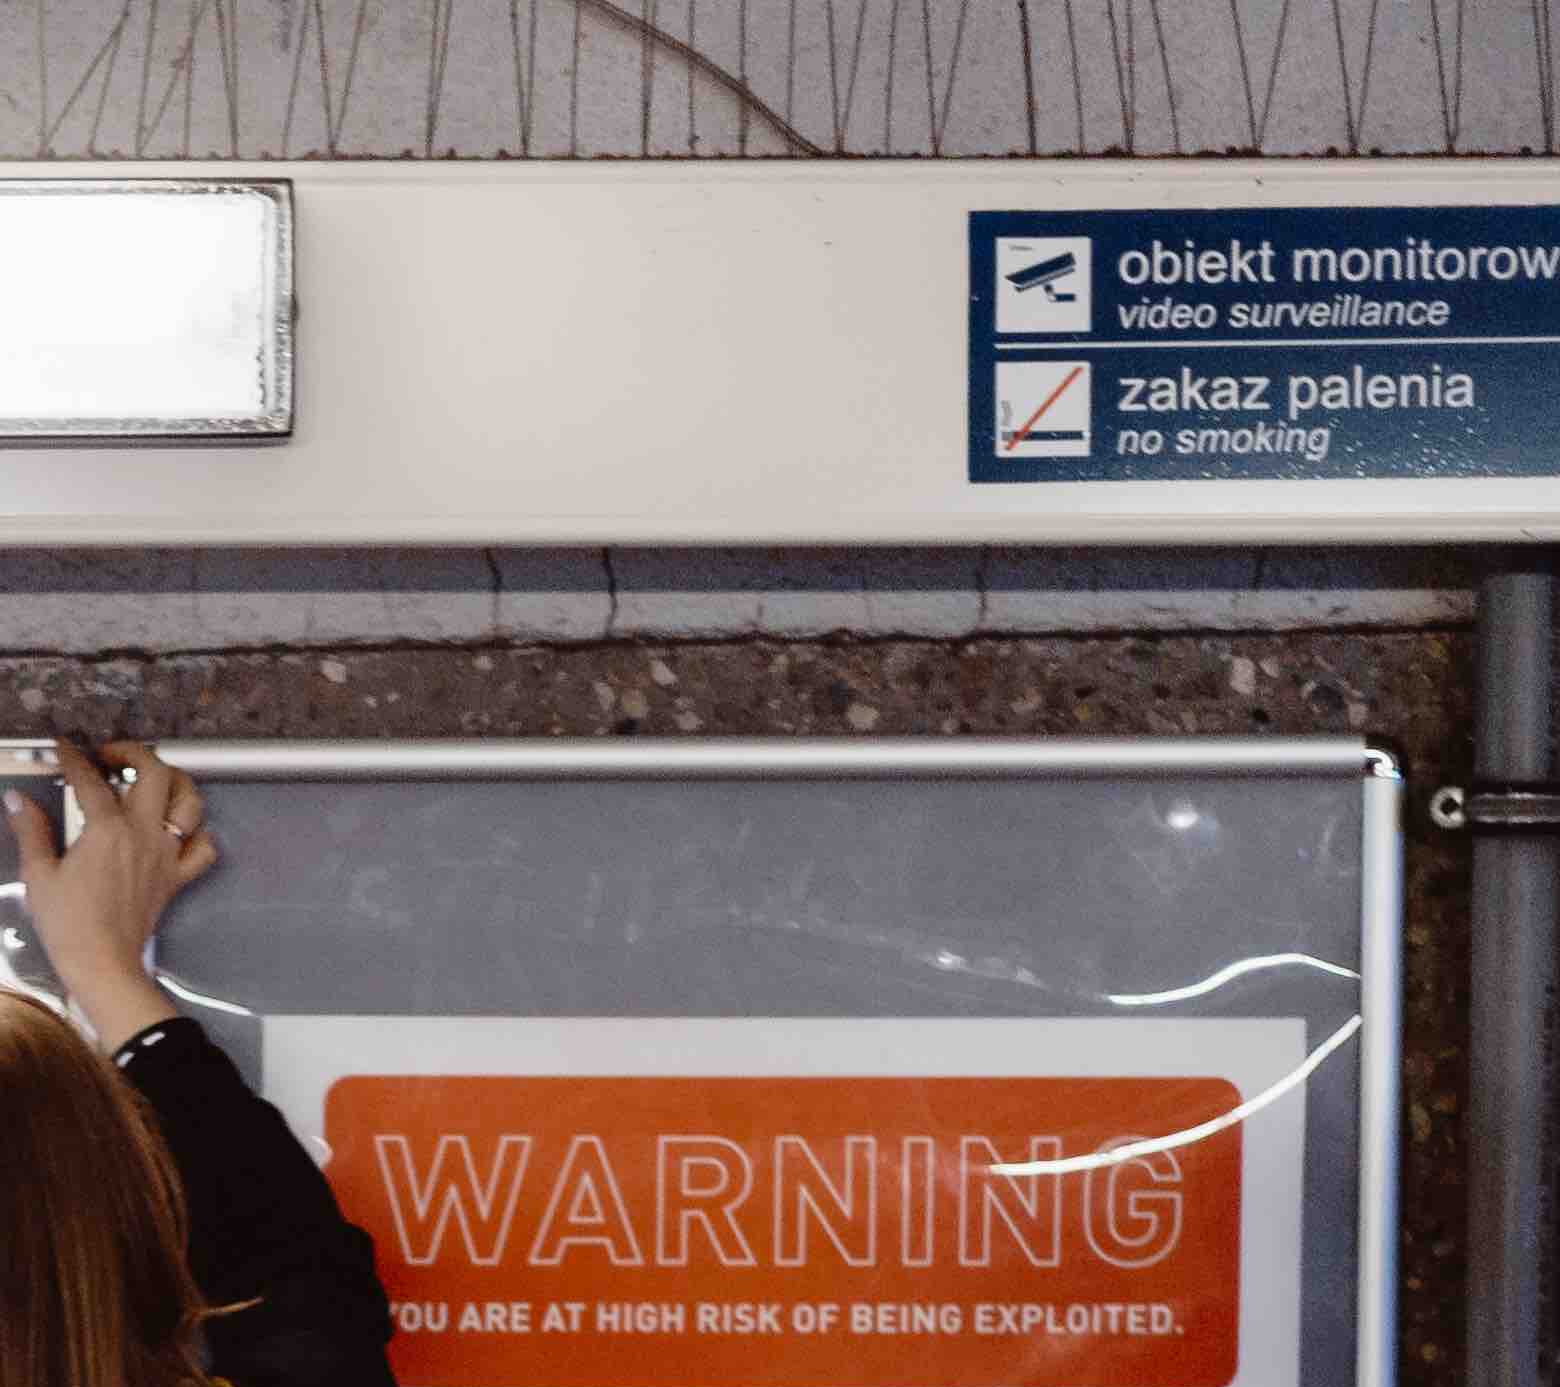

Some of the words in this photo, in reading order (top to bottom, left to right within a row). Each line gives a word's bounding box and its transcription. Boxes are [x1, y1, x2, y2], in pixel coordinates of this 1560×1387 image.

[1117, 239, 1276, 285] obiekt
[1118, 297, 1218, 329] video
[1228, 293, 1451, 329] surveillance
[1118, 368, 1271, 412] zakaz
[1289, 365, 1476, 419] palenia
[1118, 428, 1163, 456] no
[1180, 422, 1331, 461] smoking
[374, 1133, 1184, 1271] WARNING
[458, 1303, 532, 1336] ARE
[541, 1303, 588, 1336] AT
[596, 1303, 685, 1336] HIGH
[697, 1303, 785, 1336] RISK
[792, 1303, 837, 1336] OF
[849, 1303, 962, 1336] BEING
[975, 1303, 1186, 1336] EXPLOITED.
